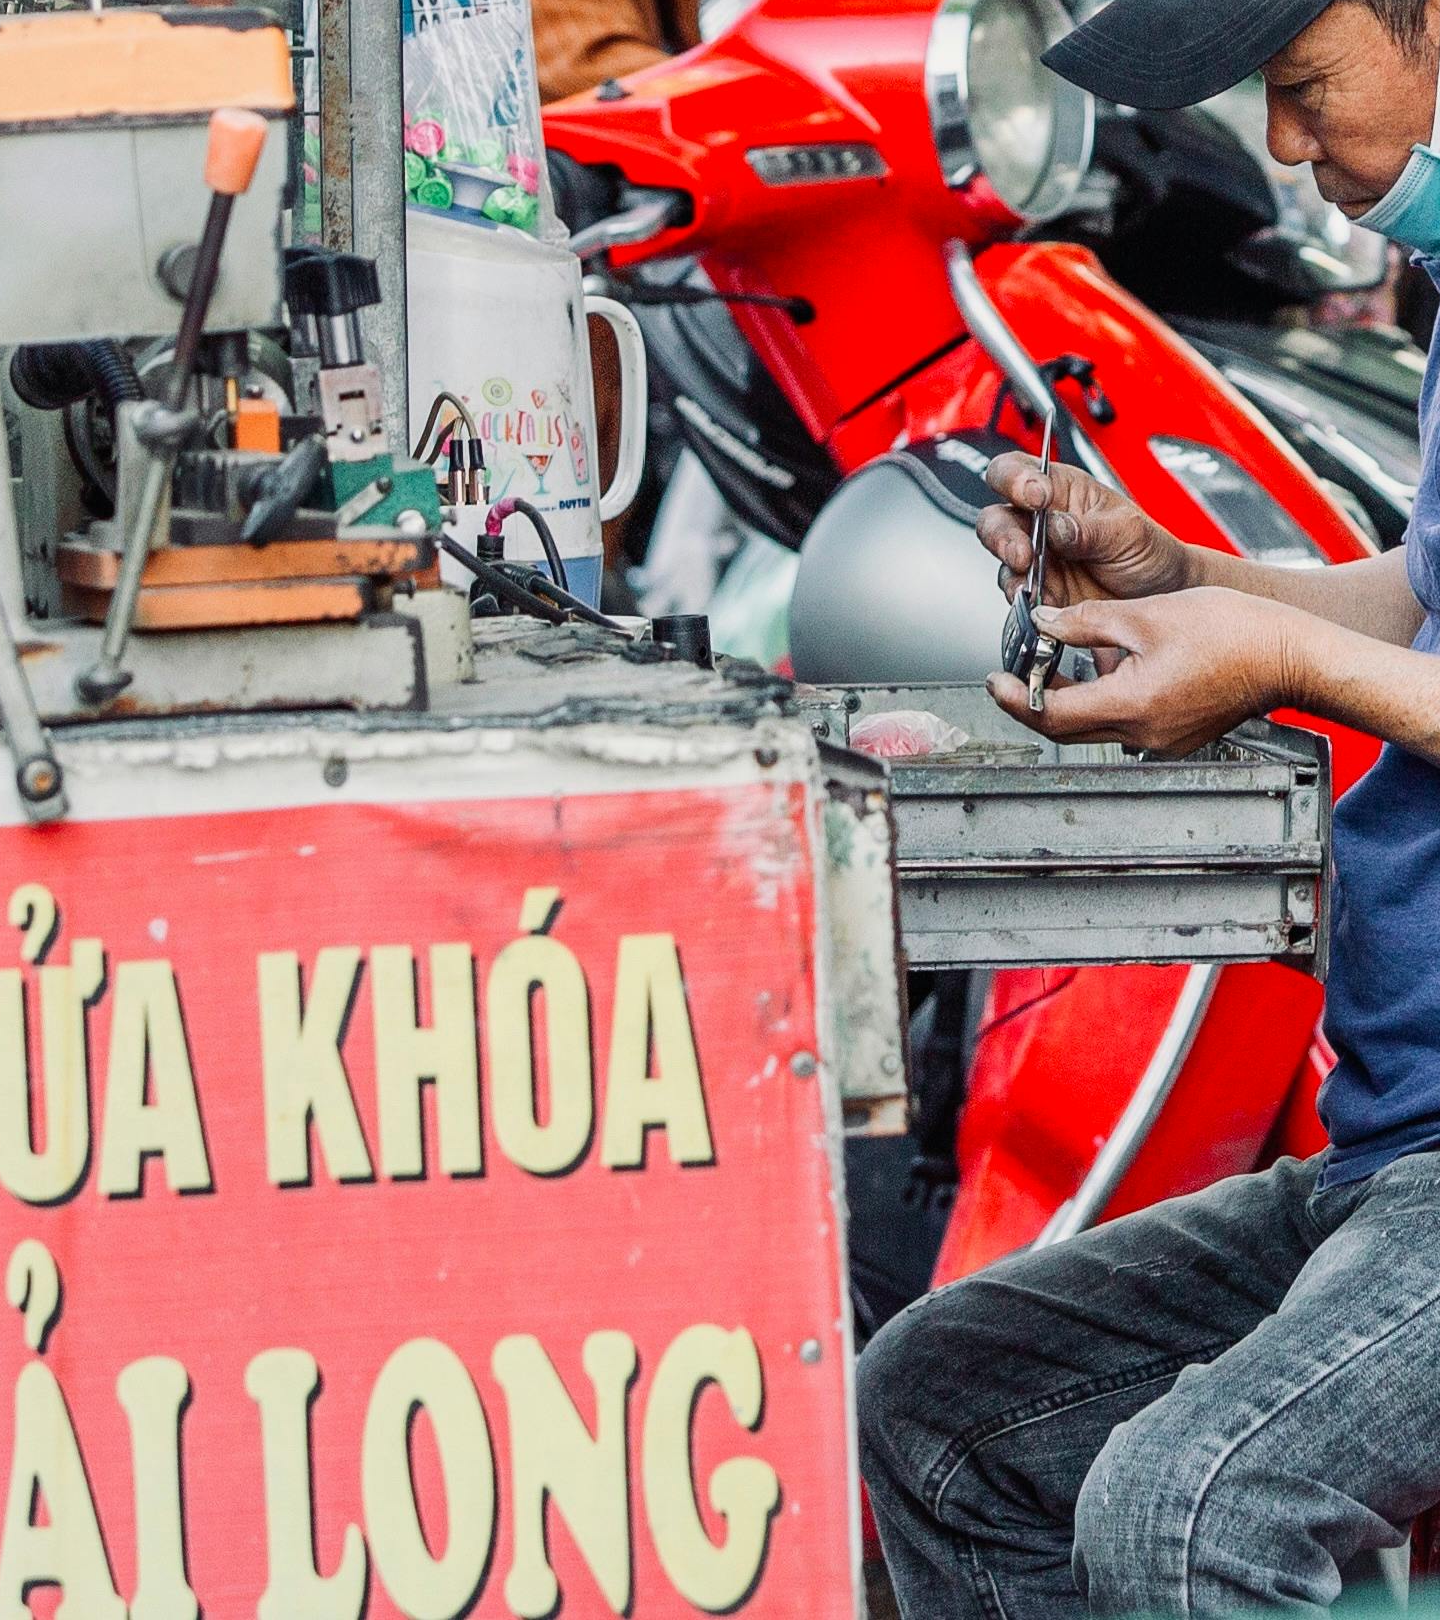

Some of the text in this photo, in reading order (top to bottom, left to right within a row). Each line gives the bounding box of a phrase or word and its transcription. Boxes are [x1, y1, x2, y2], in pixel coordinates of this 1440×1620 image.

[480, 410, 564, 447] OCKTAILS
[256, 886, 714, 1187] KHÓA
[250, 1323, 780, 1620] LONG
